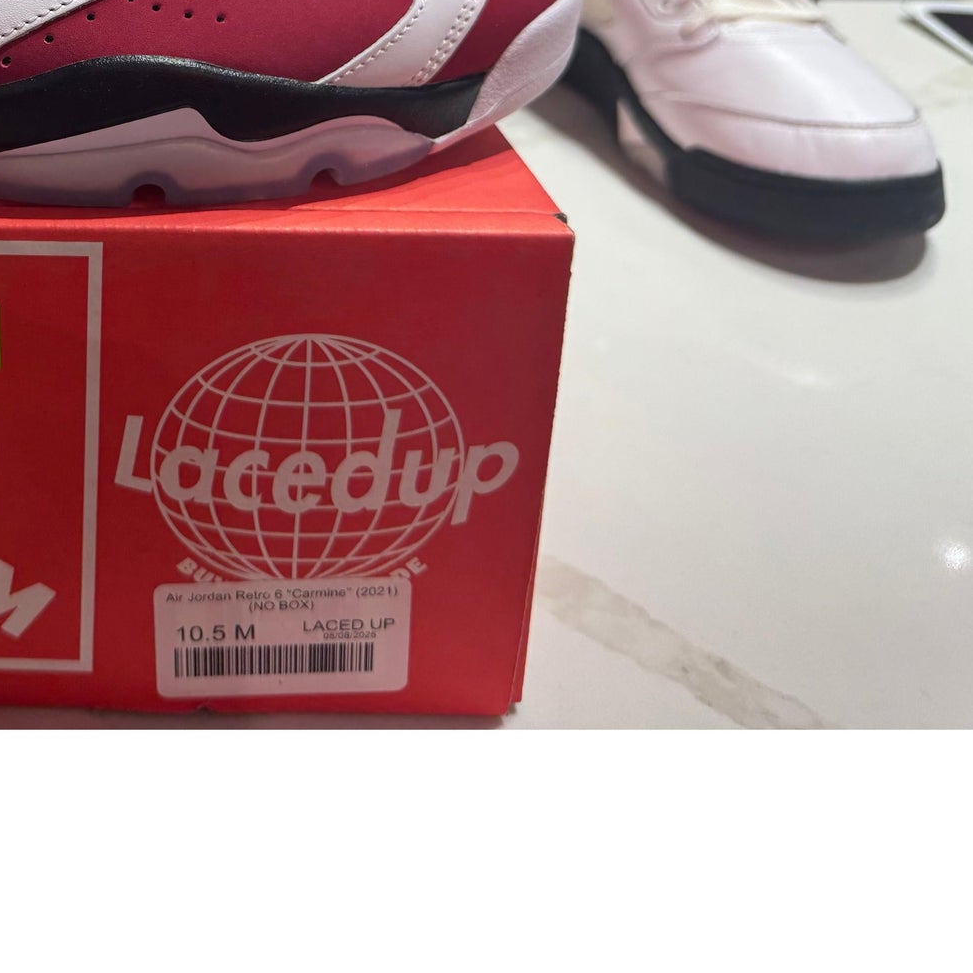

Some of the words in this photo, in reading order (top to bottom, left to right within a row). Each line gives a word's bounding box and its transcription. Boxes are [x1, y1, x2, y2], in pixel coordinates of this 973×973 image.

[166, 592, 182, 602] Air
[188, 590, 231, 602] Jordan
[235, 589, 270, 601] Retro
[274, 588, 283, 600] 6
[355, 585, 398, 599] (2021)
[248, 601, 276, 613] (NO
[279, 599, 314, 611] BOX)
[302, 618, 364, 632] LACED
[370, 617, 395, 630] UP
[176, 624, 226, 642] 10.5
[235, 624, 256, 640] M
